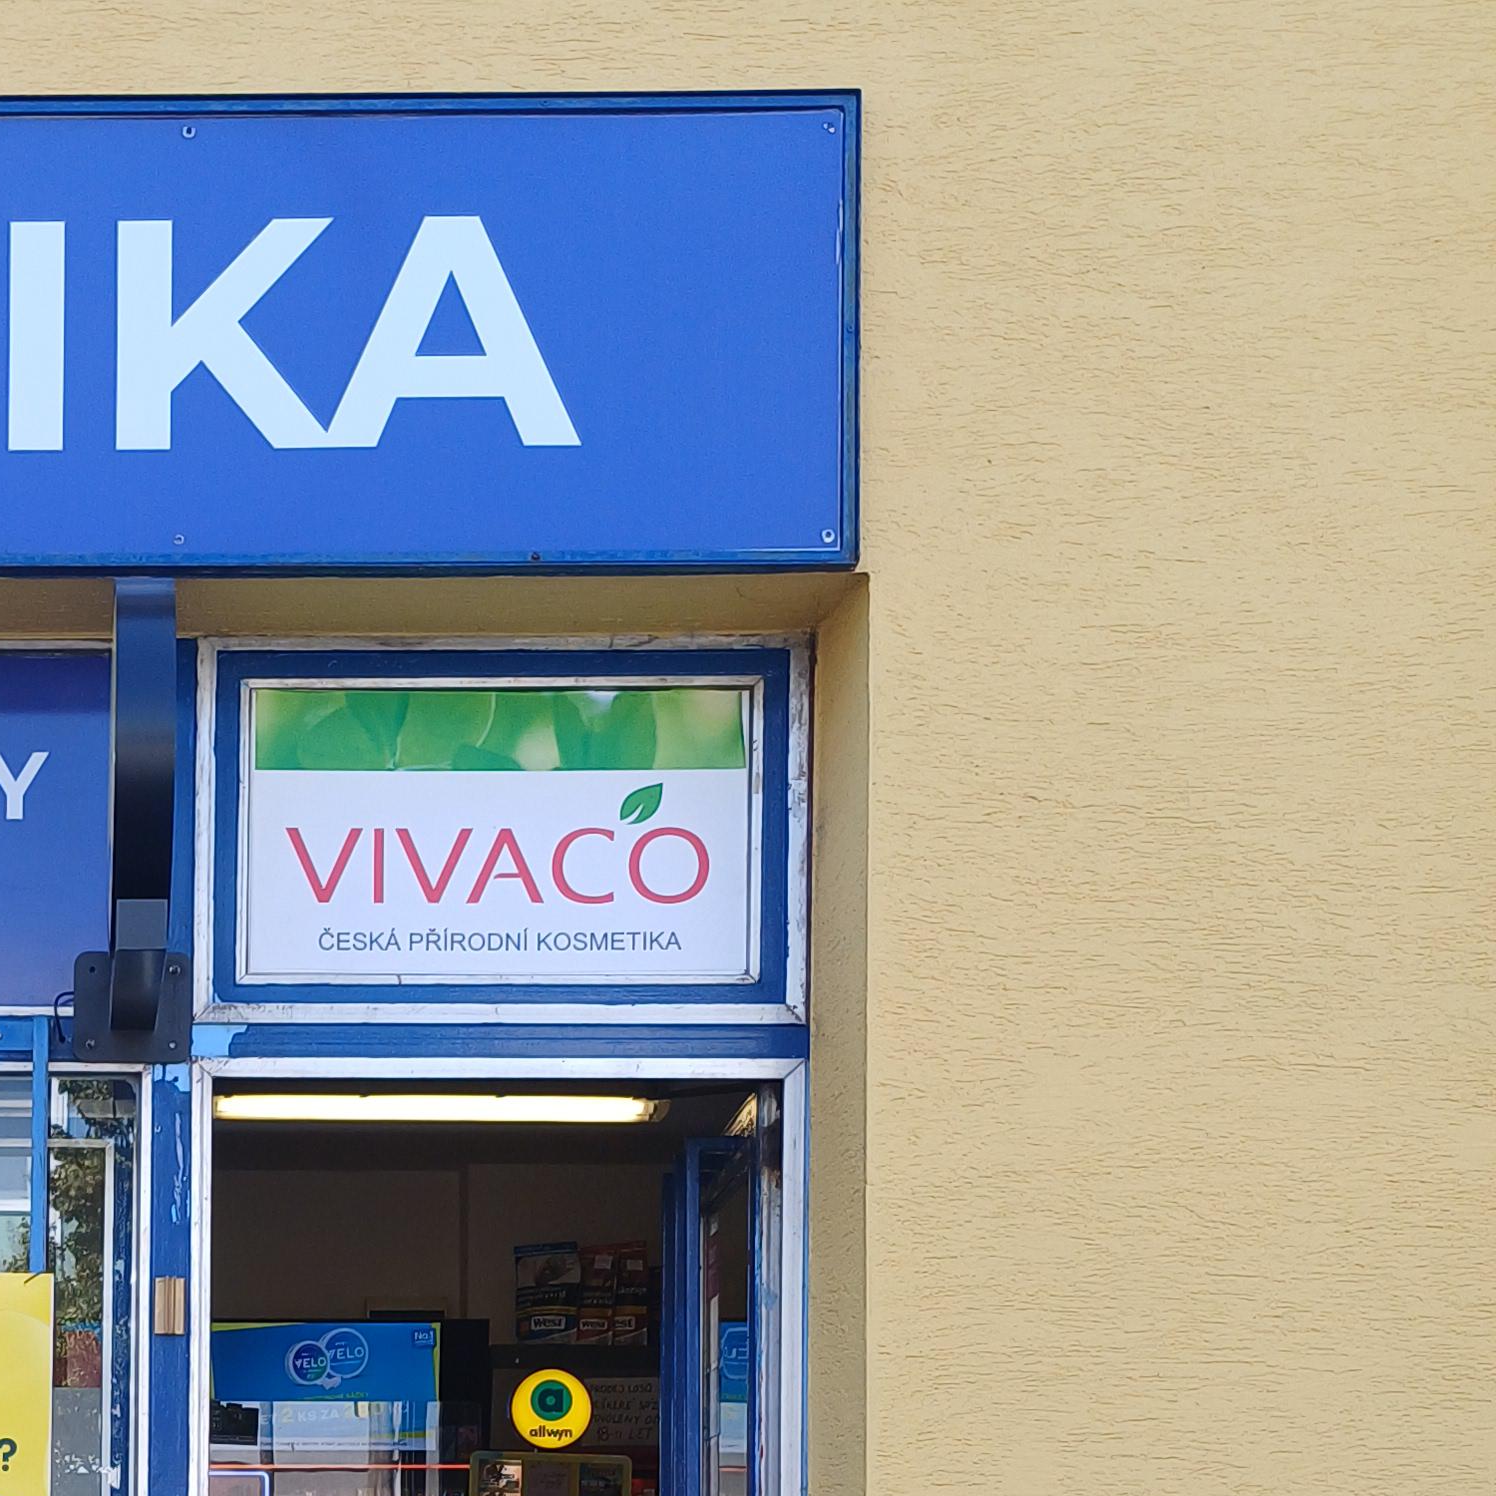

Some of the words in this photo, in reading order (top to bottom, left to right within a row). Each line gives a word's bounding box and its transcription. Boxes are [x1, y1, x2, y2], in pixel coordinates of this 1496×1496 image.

[285, 827, 711, 905] VIVACO
[318, 927, 401, 952] ČESKÁ
[409, 927, 529, 952] PŘÍRODNÍ
[537, 930, 682, 952] KOSMETIKA
[533, 1317, 564, 1329] West
[615, 1317, 633, 1328] est
[328, 1346, 365, 1361] VELO
[295, 1357, 327, 1369] VELO
[529, 1425, 573, 1441] allwyn
